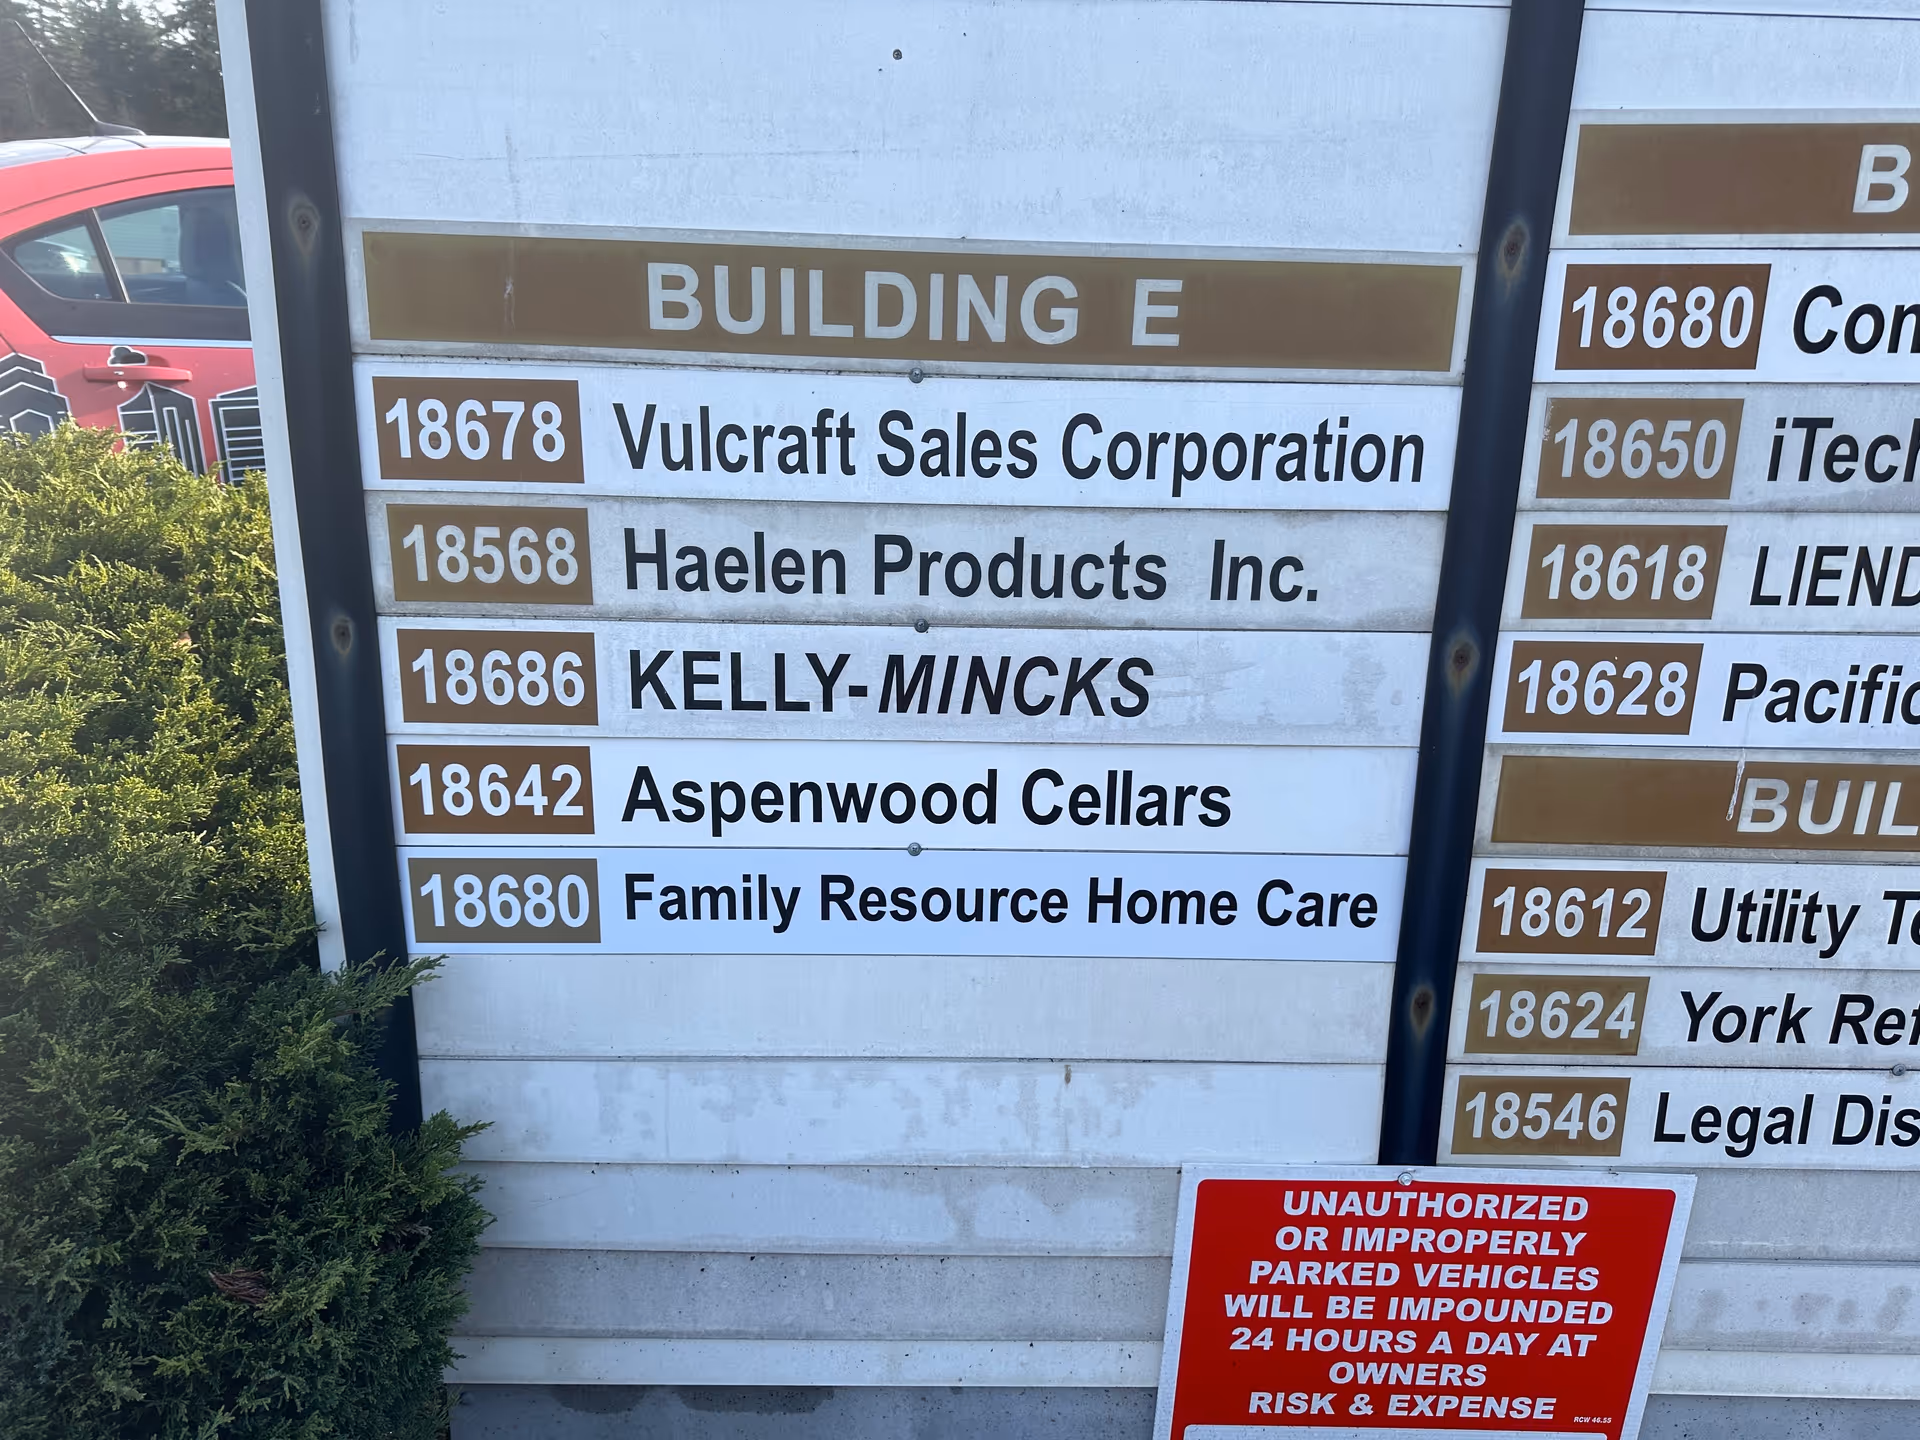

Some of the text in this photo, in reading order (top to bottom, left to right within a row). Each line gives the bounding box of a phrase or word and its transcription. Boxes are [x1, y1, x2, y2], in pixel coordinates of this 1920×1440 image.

[1852, 143, 1912, 214] B
[646, 261, 1184, 347] BUILDING E
[1571, 285, 1755, 349] 18680
[384, 397, 1425, 498] 18678 Vulcraft Sales Corporation
[1553, 418, 1727, 480] 18650
[401, 523, 1318, 603] 18568 Haelen Products Inc.
[1541, 543, 1708, 601] 18618
[411, 648, 1155, 718] 18686 KELLY-MINCKS
[1517, 659, 1689, 716] 18628
[408, 762, 1232, 838] 18642 Aspenwood Cellars
[1736, 777, 1919, 836] BUIL
[419, 872, 1379, 934] 18680 Family Resource Home Care
[1492, 886, 1652, 939] 18612
[1690, 886, 1861, 959] Utility
[1479, 989, 1636, 1040] 18624
[1679, 990, 1813, 1044] York
[1464, 1091, 1920, 1159] 18546 Legal Dis
[1282, 1190, 1589, 1222] UNAUTHORIZED
[1275, 1225, 1588, 1257] OR IMPROPERLY
[1249, 1260, 1600, 1291] PARKED VEHICLES
[1224, 1294, 1614, 1325] WILL BE IMPOUNDED
[1229, 1326, 1598, 1358] 24 HOURS A DAY AT
[1328, 1361, 1488, 1387] OWNERS
[1248, 1391, 1557, 1421] RISK & EXPENSE
